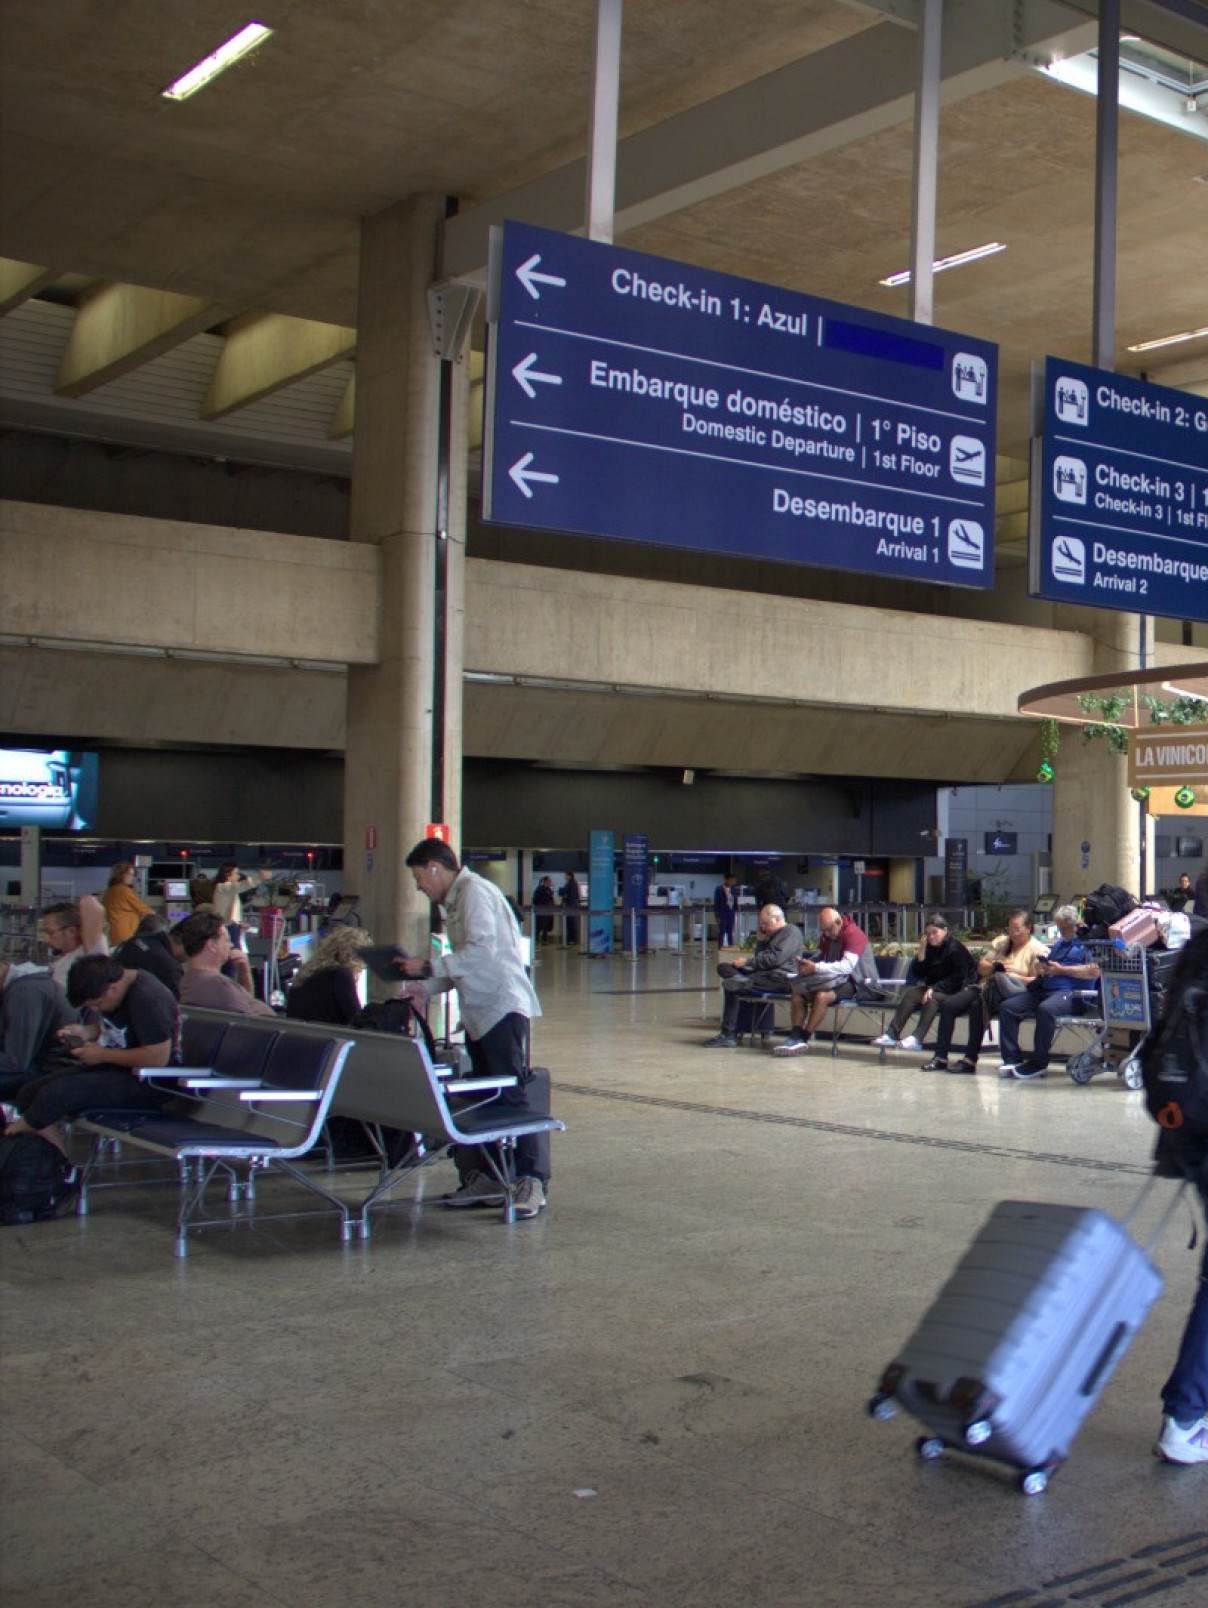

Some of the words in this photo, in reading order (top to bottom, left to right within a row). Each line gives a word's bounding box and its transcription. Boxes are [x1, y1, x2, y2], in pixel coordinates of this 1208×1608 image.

[611, 268, 721, 316] Check-in
[730, 298, 750, 323] 1:
[757, 304, 807, 336] Azul
[589, 360, 720, 410] Embarque
[726, 389, 847, 434] doméstico
[896, 421, 941, 453] Piso
[1096, 386, 1170, 423] Check-in
[1175, 407, 1190, 428] 2:
[682, 412, 767, 446] Domestic
[771, 429, 855, 463] Departure
[873, 449, 897, 470] 1st
[901, 455, 941, 478] Floor
[1095, 464, 1170, 498] Check-in
[1174, 481, 1185, 501] 3
[773, 487, 925, 537] Desembarque
[931, 515, 940, 537] 1
[1094, 491, 1152, 518] Check-in
[1154, 504, 1163, 520] 3
[1176, 509, 1194, 526] 1st
[876, 538, 928, 562] Arrival
[932, 547, 939, 563] 1
[1093, 542, 1208, 583] Desembarque
[1093, 571, 1137, 592] Arrival
[1139, 579, 1148, 594] 2
[1135, 747, 1153, 767] LA
